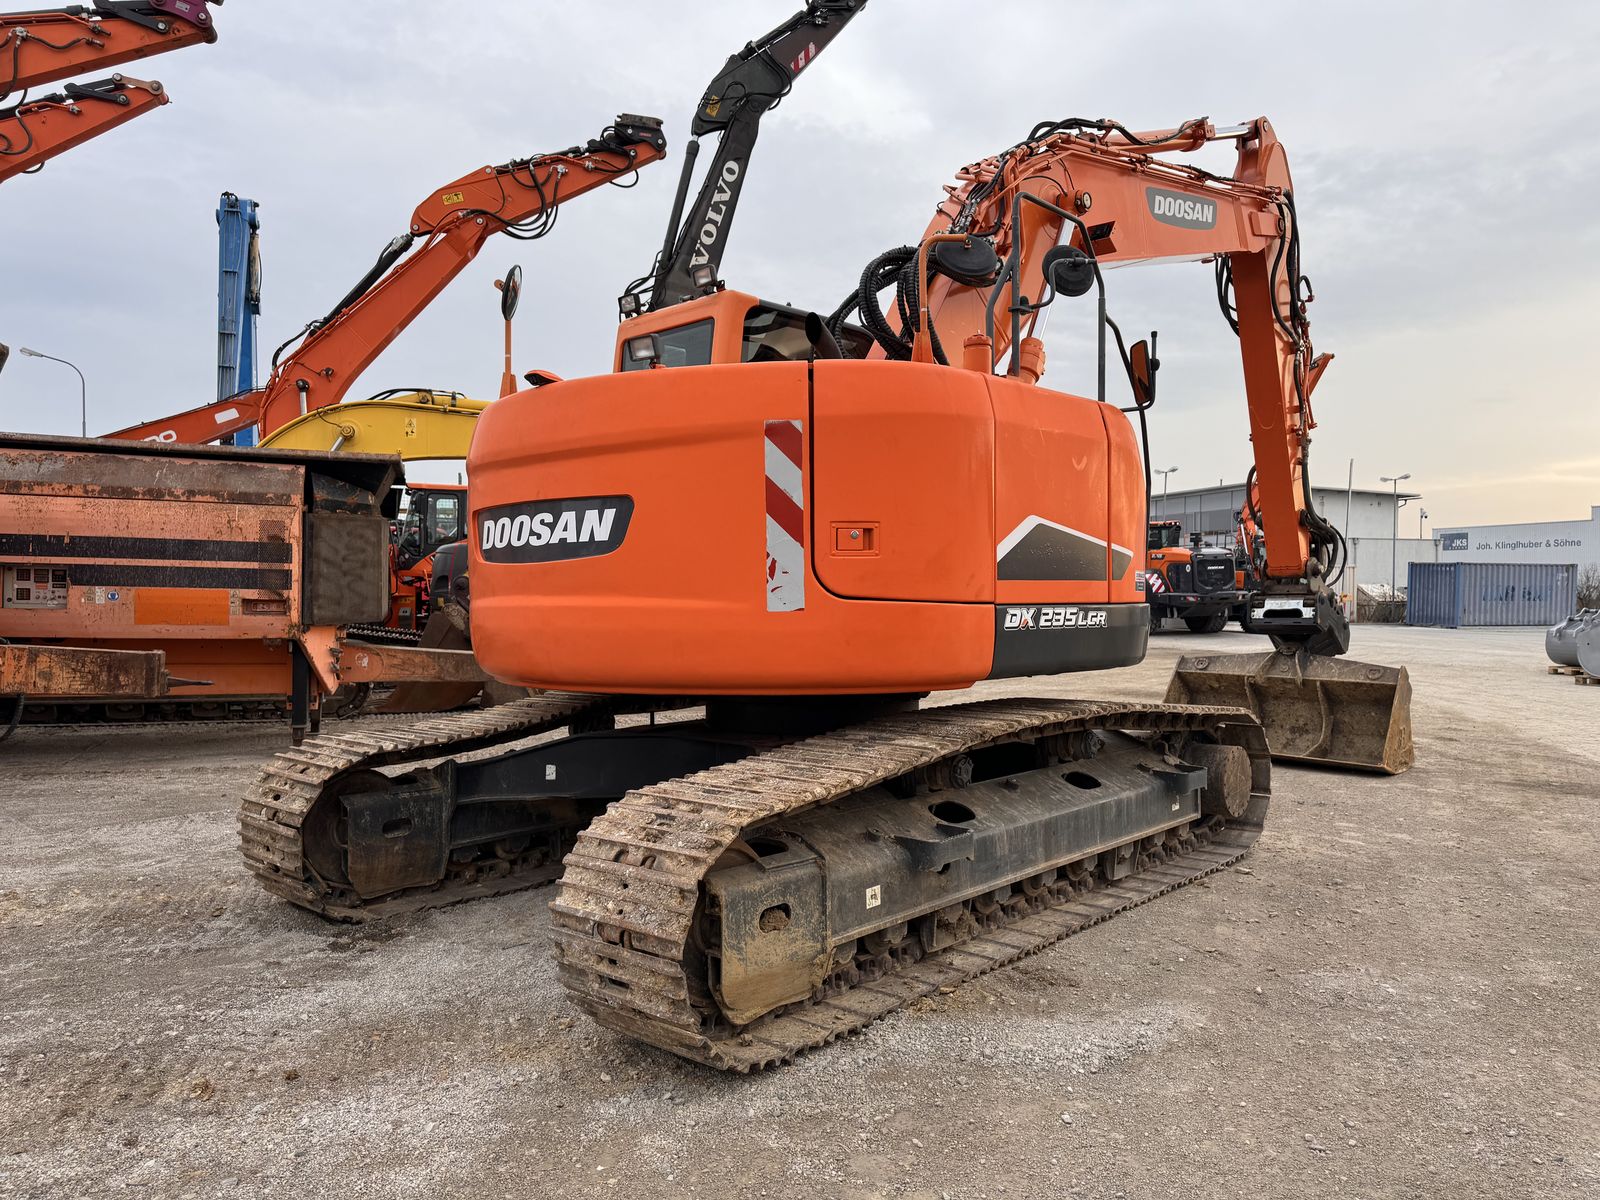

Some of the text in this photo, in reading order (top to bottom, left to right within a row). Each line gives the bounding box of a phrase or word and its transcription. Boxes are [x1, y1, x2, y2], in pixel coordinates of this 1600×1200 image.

[689, 160, 740, 268] VOLVO
[1154, 195, 1214, 223] DOOSAN
[482, 508, 617, 550] DOOSAN
[1451, 538, 1468, 547] JKS
[1476, 541, 1493, 550] Joh.
[1495, 540, 1543, 551] Klinglhuber
[1545, 539, 1552, 548] &
[1553, 538, 1582, 547] Söhne
[1004, 607, 1037, 631] DX
